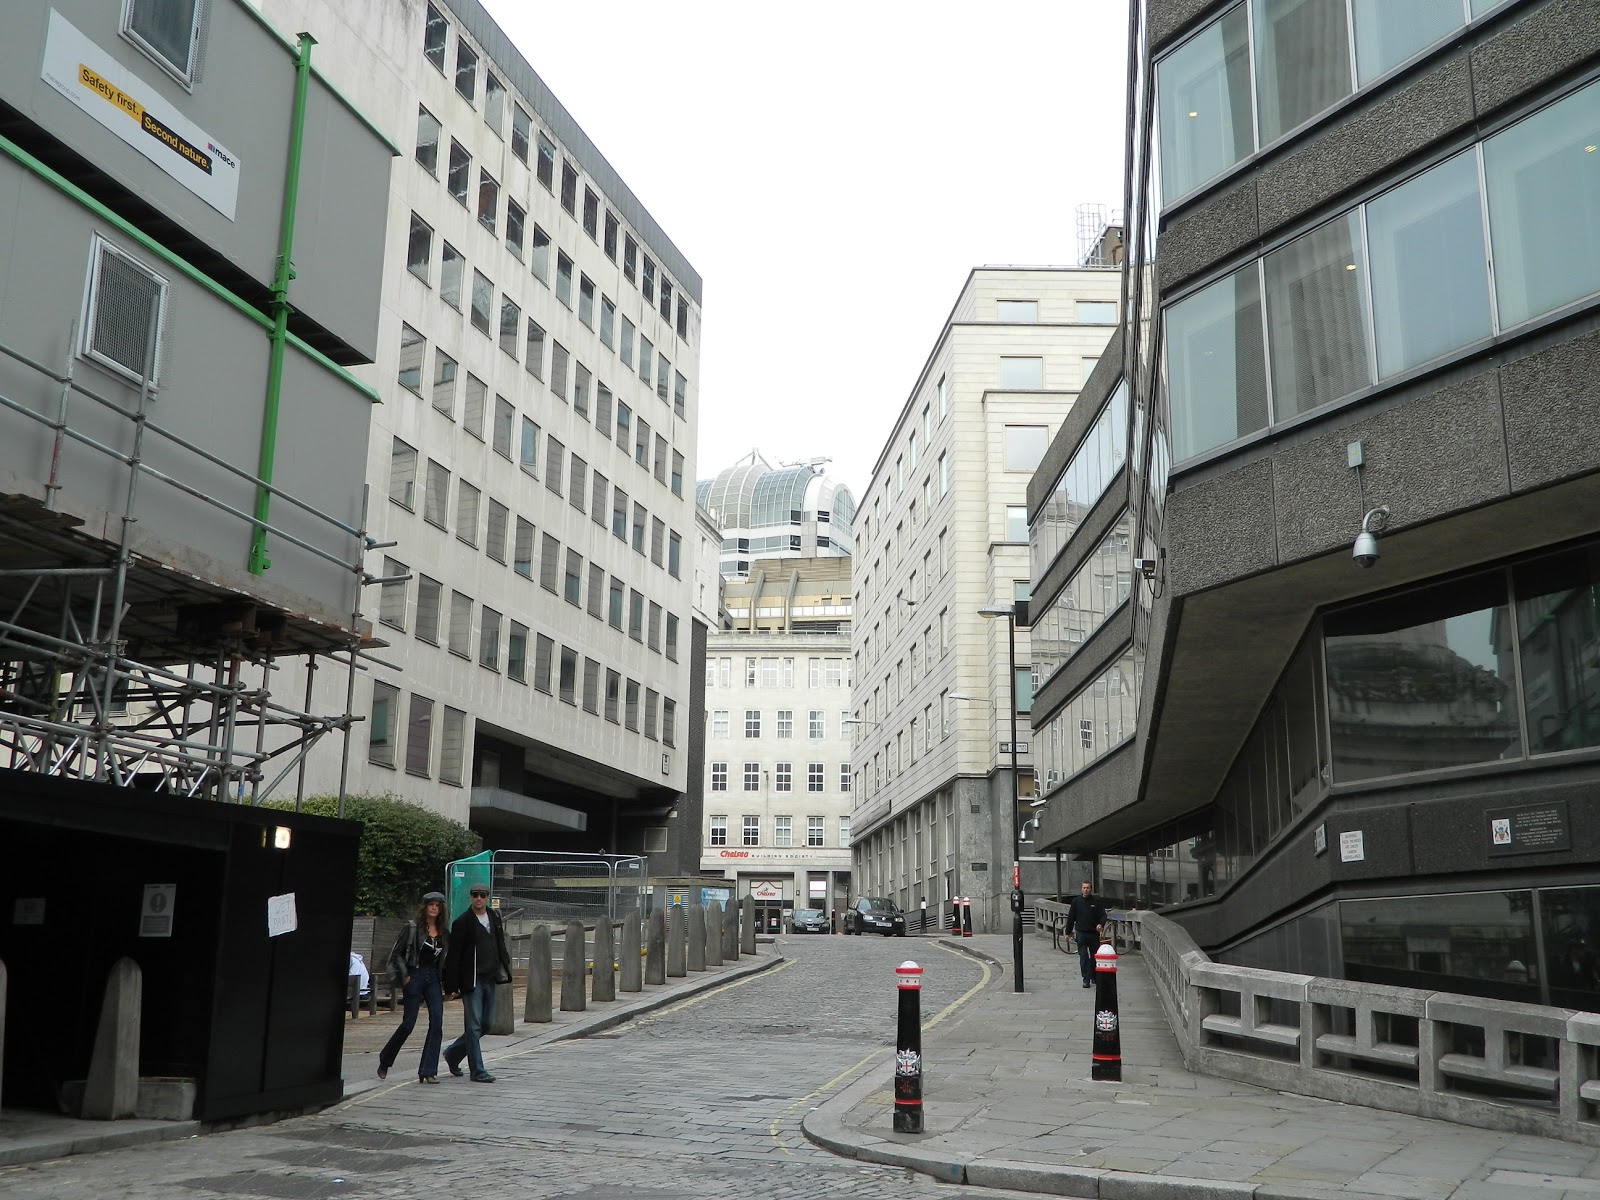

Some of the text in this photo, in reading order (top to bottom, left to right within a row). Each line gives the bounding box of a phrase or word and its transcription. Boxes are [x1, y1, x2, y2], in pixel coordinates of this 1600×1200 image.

[82, 69, 139, 115] Safety first.
[144, 116, 209, 169] Second nature.
[215, 148, 236, 169] mace
[720, 850, 749, 858] Chelsea
